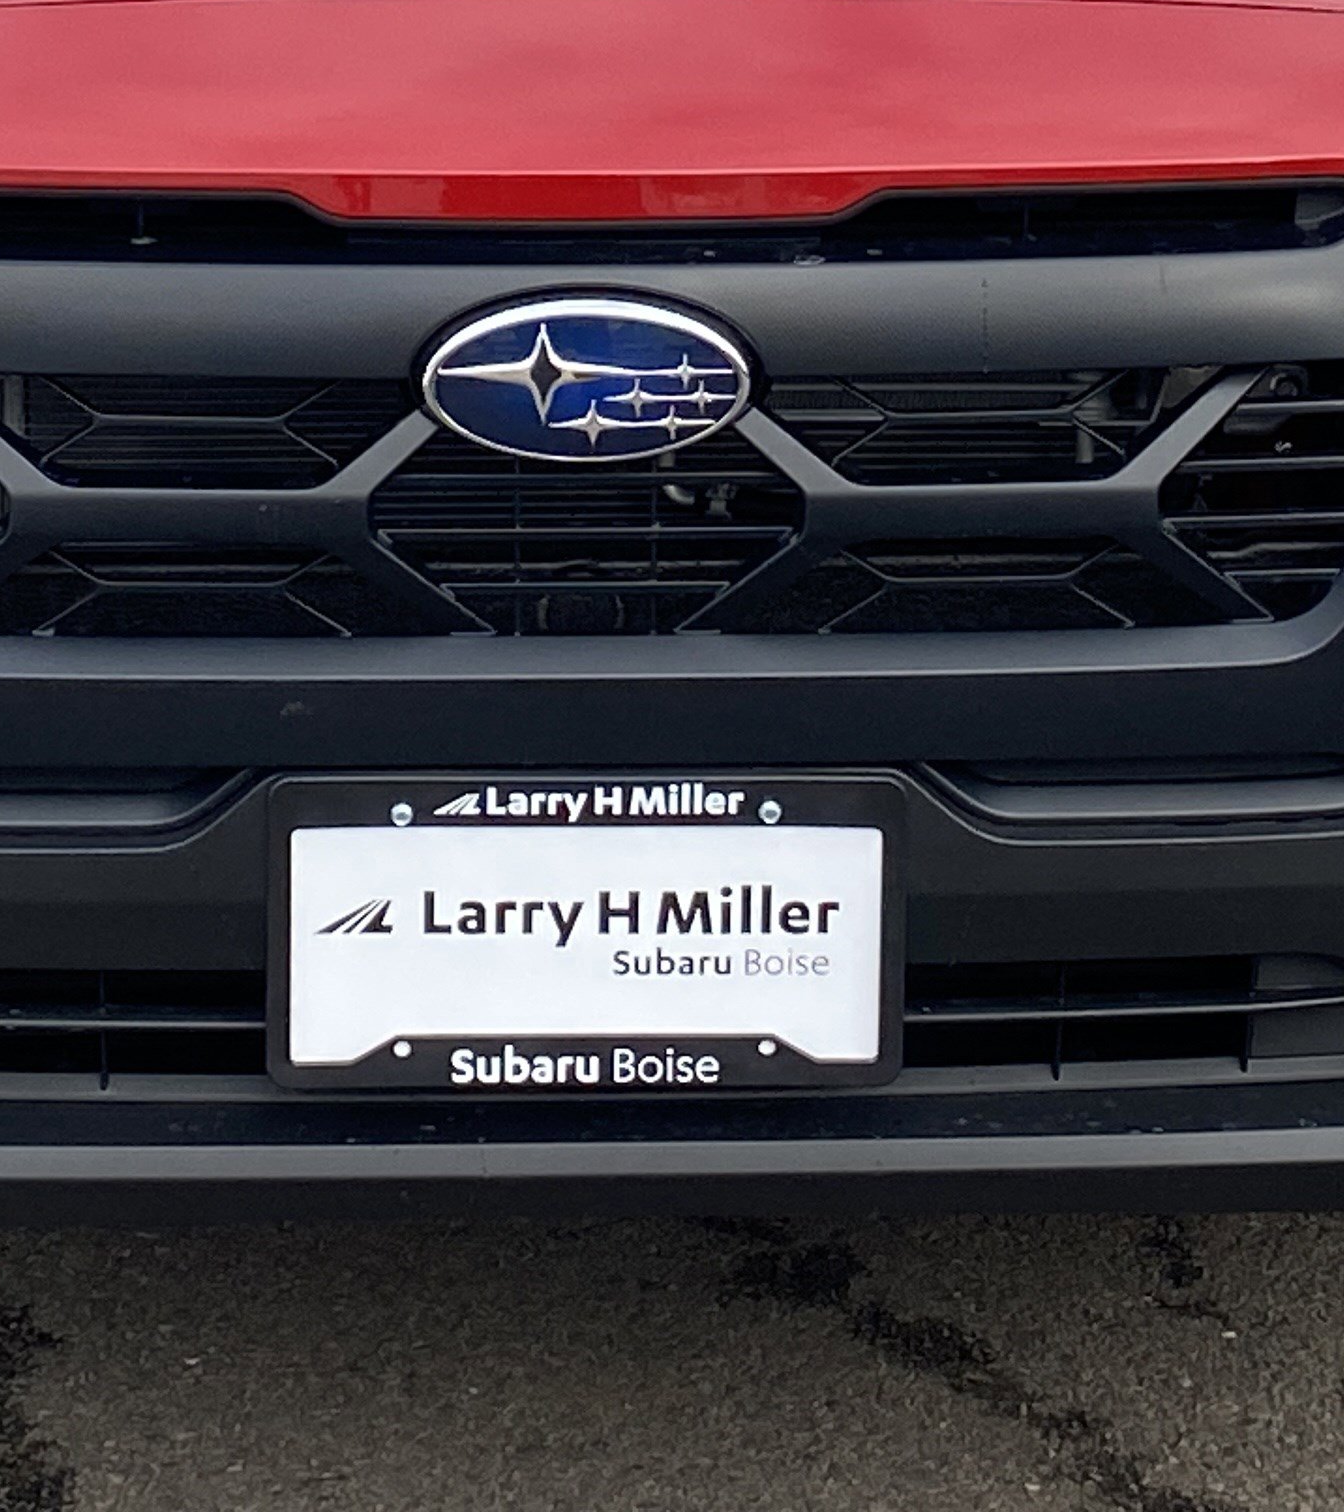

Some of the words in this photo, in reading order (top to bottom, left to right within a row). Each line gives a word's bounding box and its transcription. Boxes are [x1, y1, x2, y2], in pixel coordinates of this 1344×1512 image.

[485, 786, 588, 823] Larry
[593, 786, 623, 816] H
[627, 782, 745, 816] Miller
[423, 890, 585, 948] Larry
[598, 890, 640, 935] H
[656, 884, 840, 935] Miller
[612, 946, 732, 977] Subaru
[744, 948, 830, 976] Boise
[450, 1044, 600, 1084] Subaru
[612, 1047, 720, 1084] Boise
